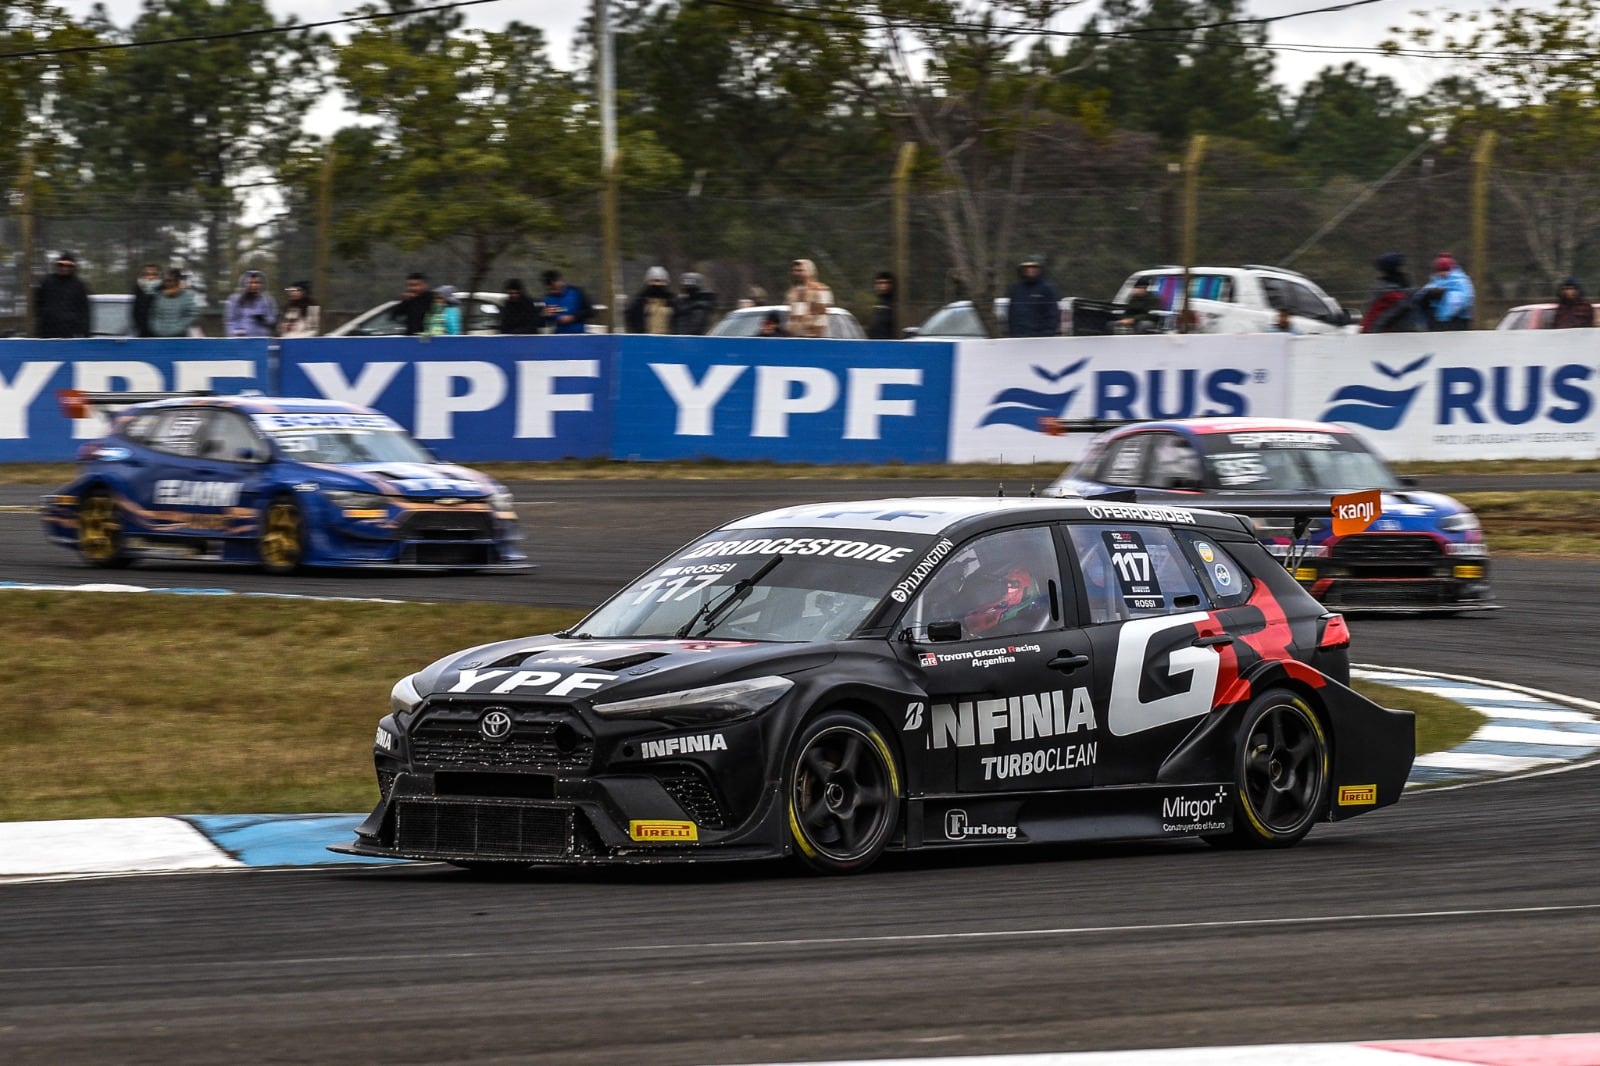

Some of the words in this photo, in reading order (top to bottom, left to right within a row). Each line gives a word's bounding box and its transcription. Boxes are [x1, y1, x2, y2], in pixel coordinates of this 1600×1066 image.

[297, 359, 600, 439] YPF
[647, 363, 923, 439] YPF
[1092, 369, 1250, 419] RUS
[1435, 364, 1594, 425] RUS
[679, 538, 914, 564] BRIDGESTONE
[679, 563, 737, 575] ROSSI
[897, 538, 954, 595] PILKINGTON
[1111, 552, 1150, 582] 117
[631, 574, 724, 605] 117
[1135, 600, 1156, 608] ROSSI
[937, 651, 973, 662] TOYOTA
[1008, 644, 1041, 654] Racing
[448, 670, 620, 696] YPF
[926, 687, 1098, 750] NFINIA
[641, 733, 728, 759] INFINIA
[981, 741, 1098, 781] TURBOCLEAN
[1342, 788, 1373, 801] PIRELLI
[1163, 796, 1217, 822] Mirgor
[636, 824, 690, 837] PIRELLI
[949, 813, 1018, 839] Furlong
